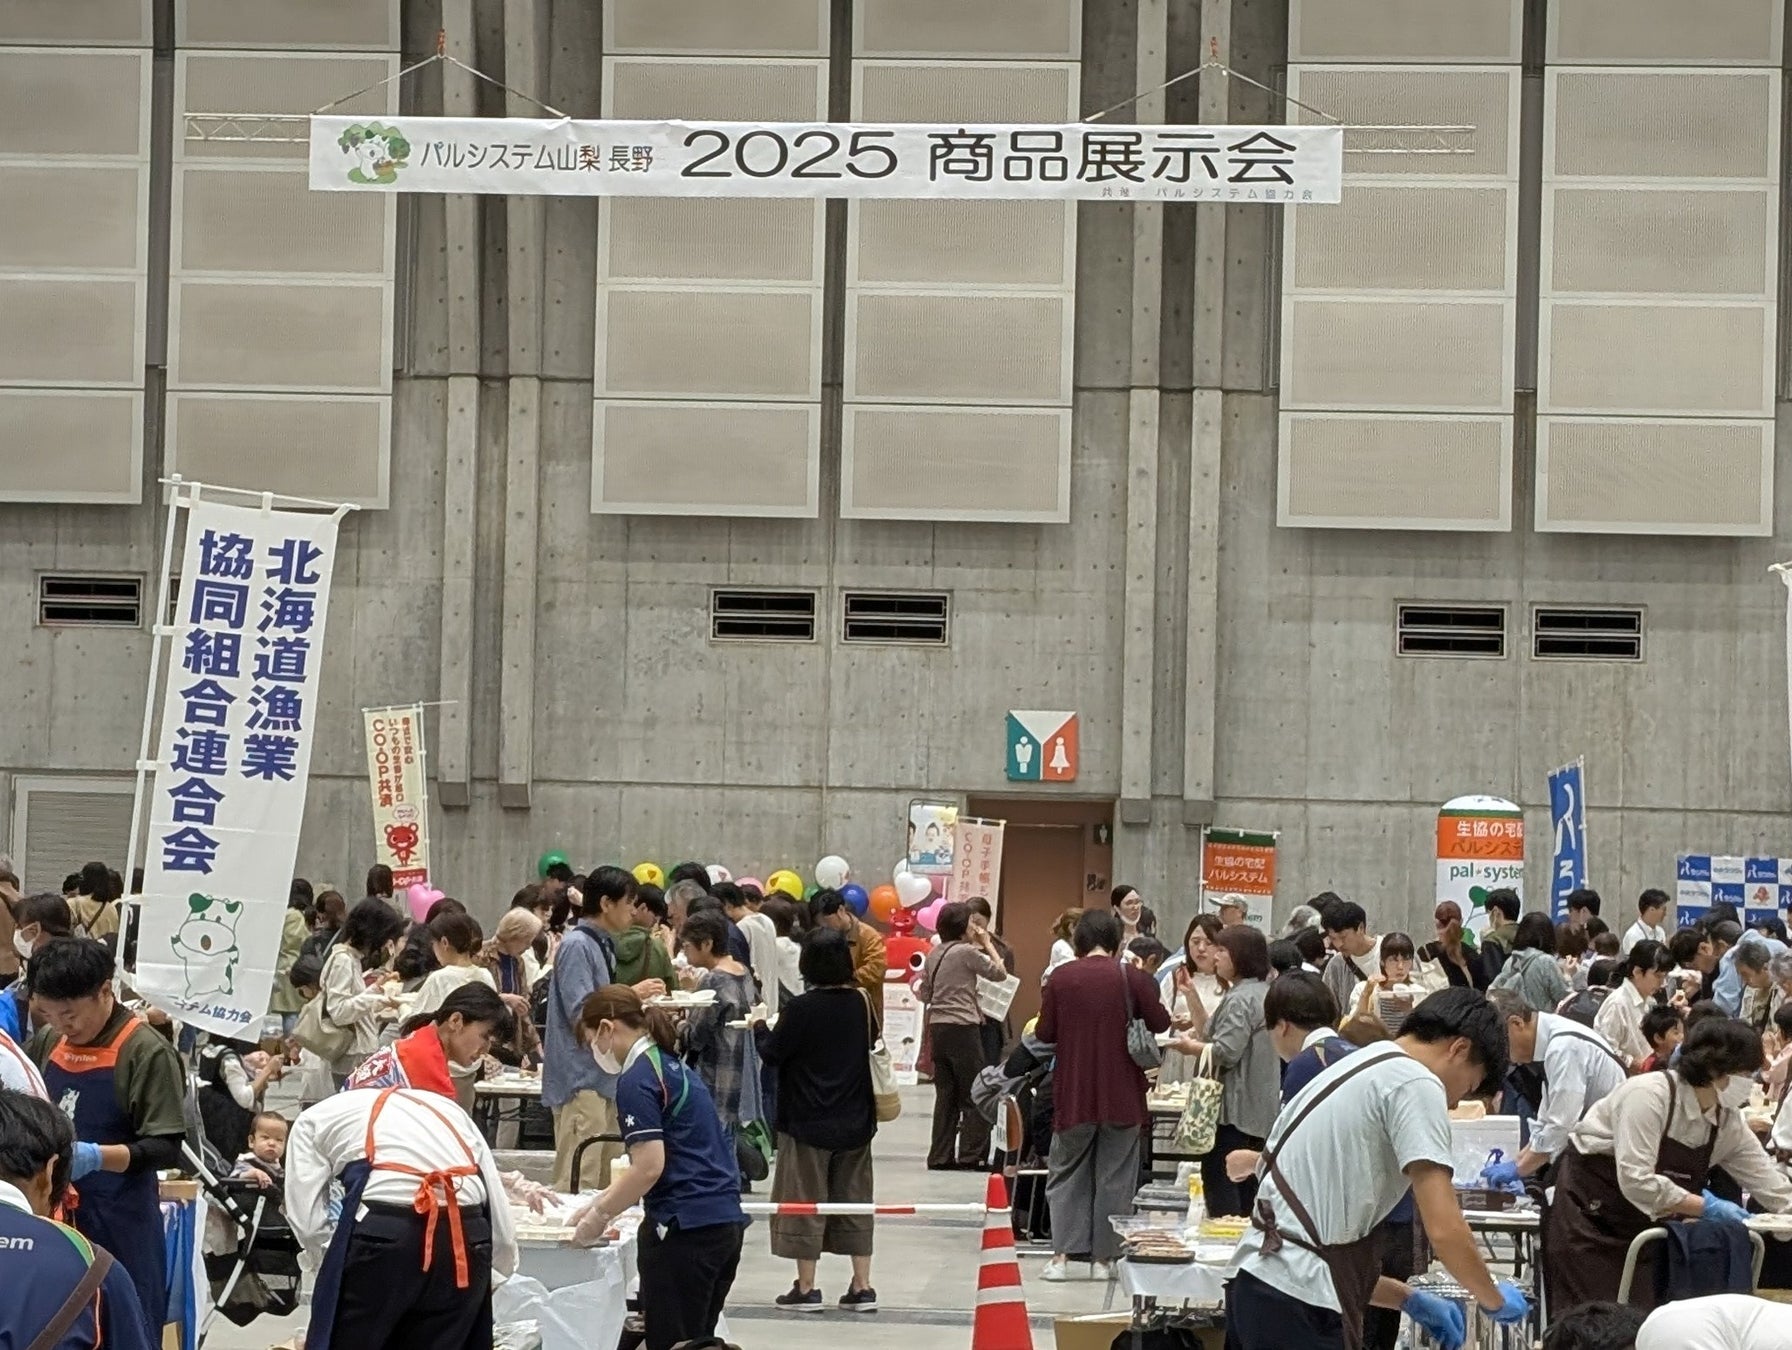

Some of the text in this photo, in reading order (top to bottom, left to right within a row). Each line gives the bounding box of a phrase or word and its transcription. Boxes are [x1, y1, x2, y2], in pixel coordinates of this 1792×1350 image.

[420, 128, 1297, 185] パルシステム山梨 長野 2025 商品展示会
[162, 529, 254, 875] 協同組合連合会
[240, 538, 323, 782] 北海道漁業
